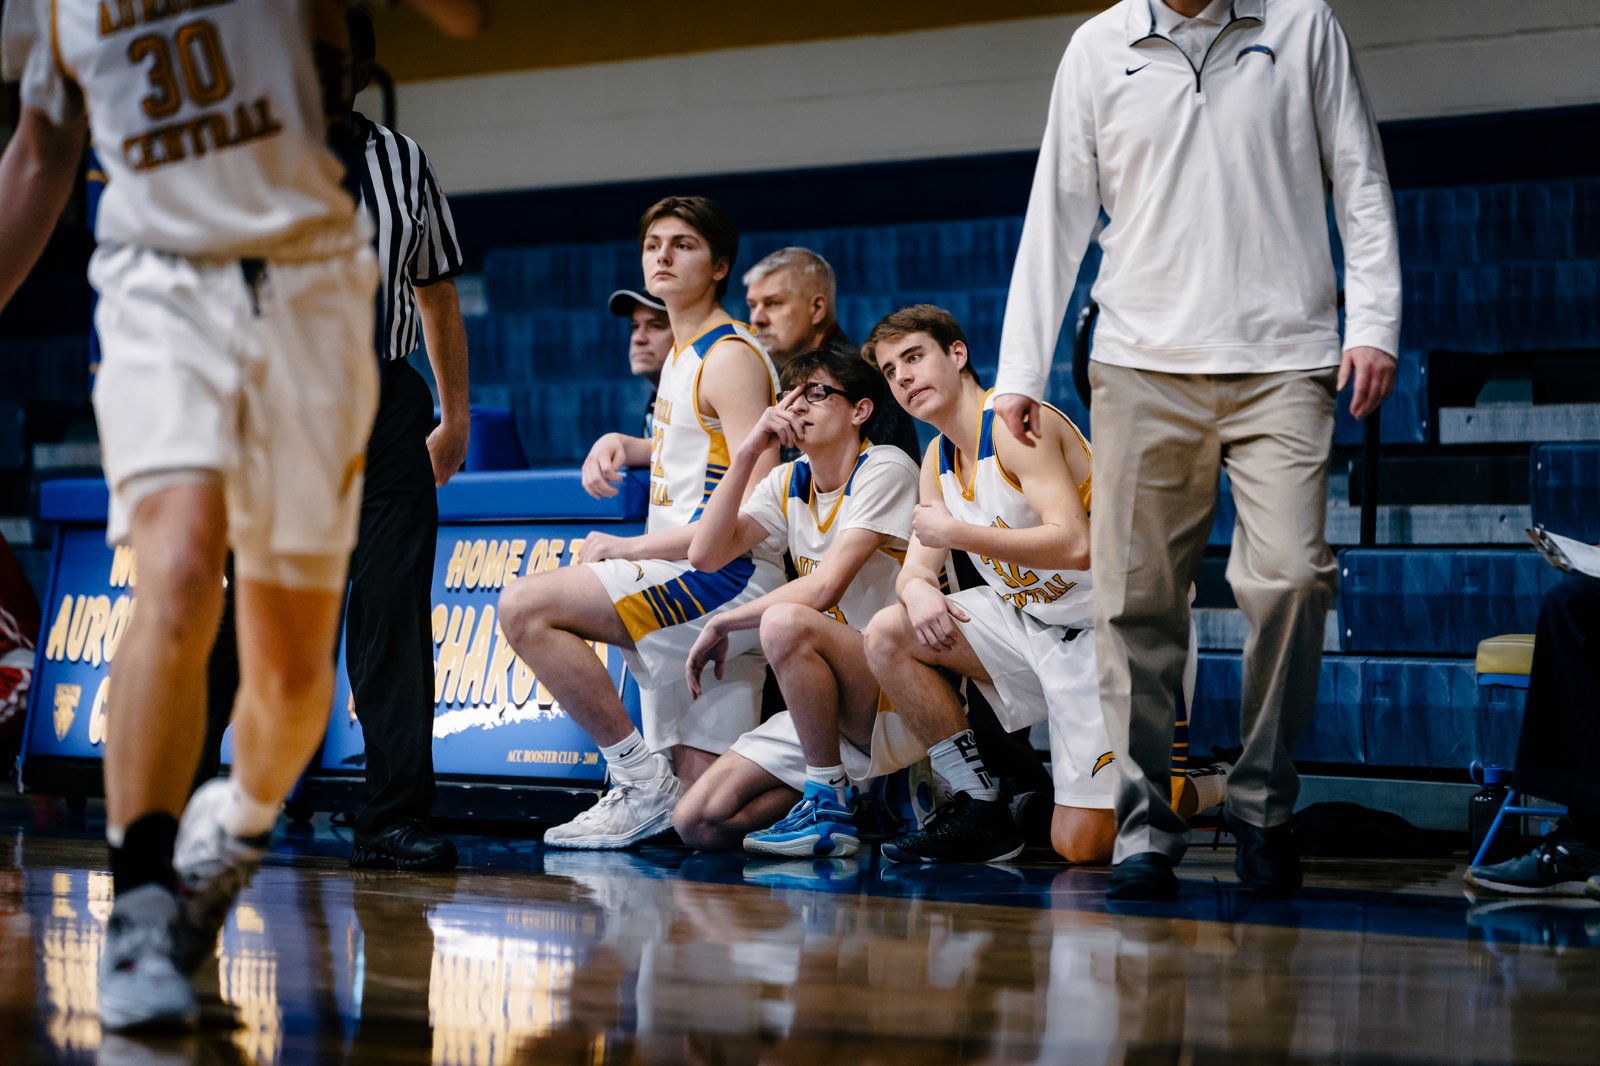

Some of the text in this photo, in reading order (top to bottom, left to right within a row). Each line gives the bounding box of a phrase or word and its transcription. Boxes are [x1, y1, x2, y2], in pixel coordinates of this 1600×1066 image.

[127, 18, 234, 121] 30
[122, 96, 283, 173] CENTRAL
[445, 539, 526, 590] HOME
[526, 538, 565, 586] OF
[1000, 573, 1078, 609] NTRAL
[45, 593, 138, 669] AURO
[507, 749, 523, 762] ACC
[523, 749, 558, 763] BOOSTER
[558, 751, 579, 764] CLUB
